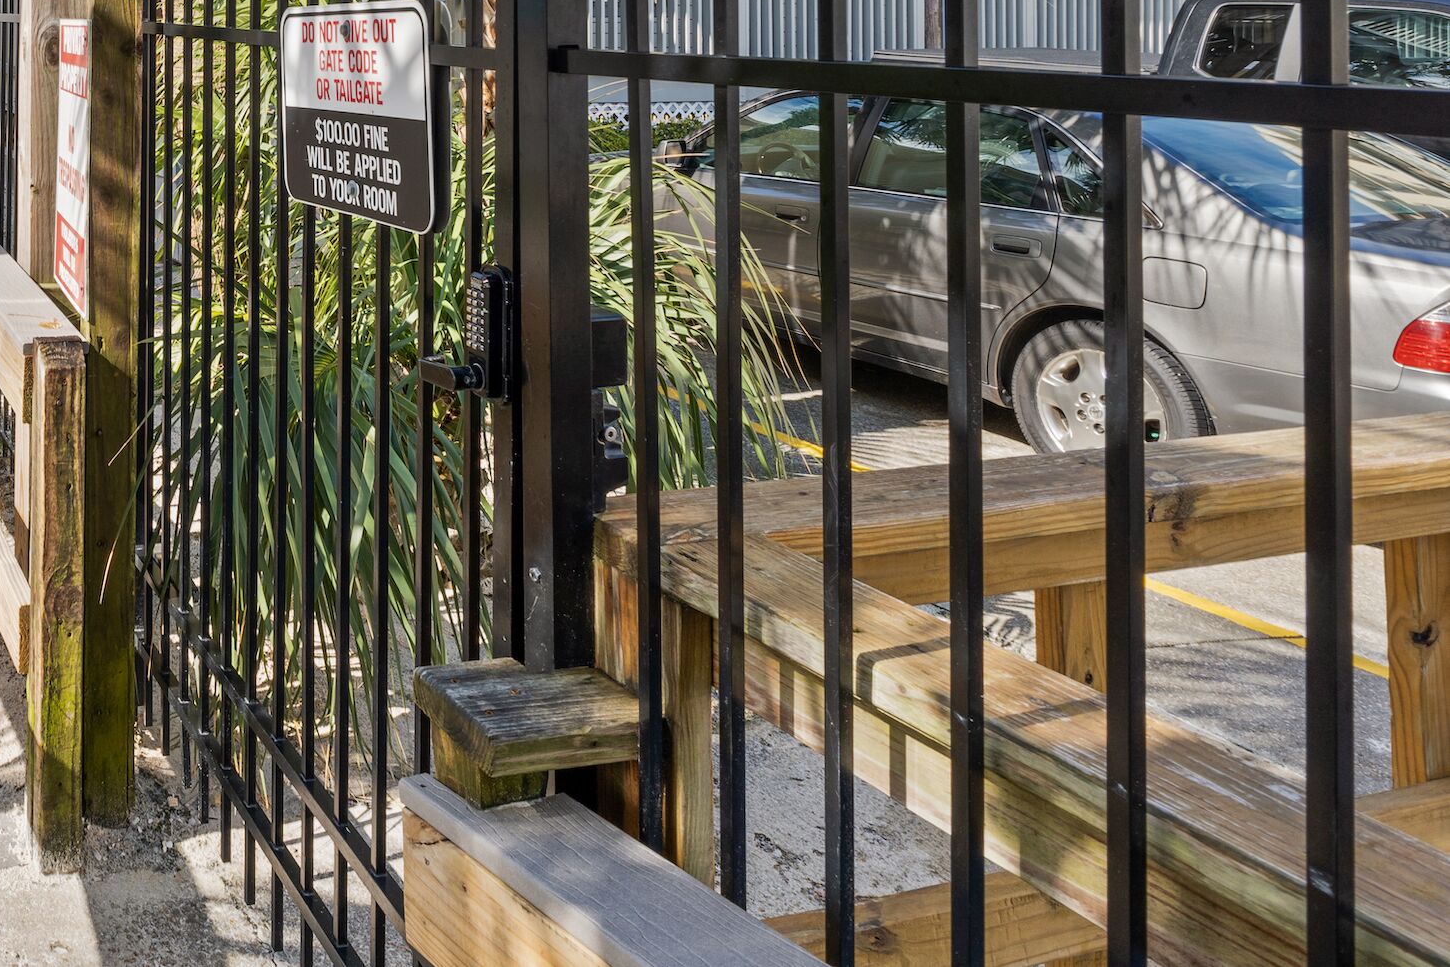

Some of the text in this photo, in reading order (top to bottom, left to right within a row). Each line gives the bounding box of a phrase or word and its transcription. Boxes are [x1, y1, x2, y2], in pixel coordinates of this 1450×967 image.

[302, 18, 396, 43] DO NOT IVE OUT
[319, 50, 378, 74] GATE CODE
[316, 78, 384, 105] OR TAILGATE
[315, 117, 389, 152] $100.00 FINE
[306, 145, 402, 186] WILL BE APPLIED
[312, 174, 397, 216] TO YOUR ROOM
